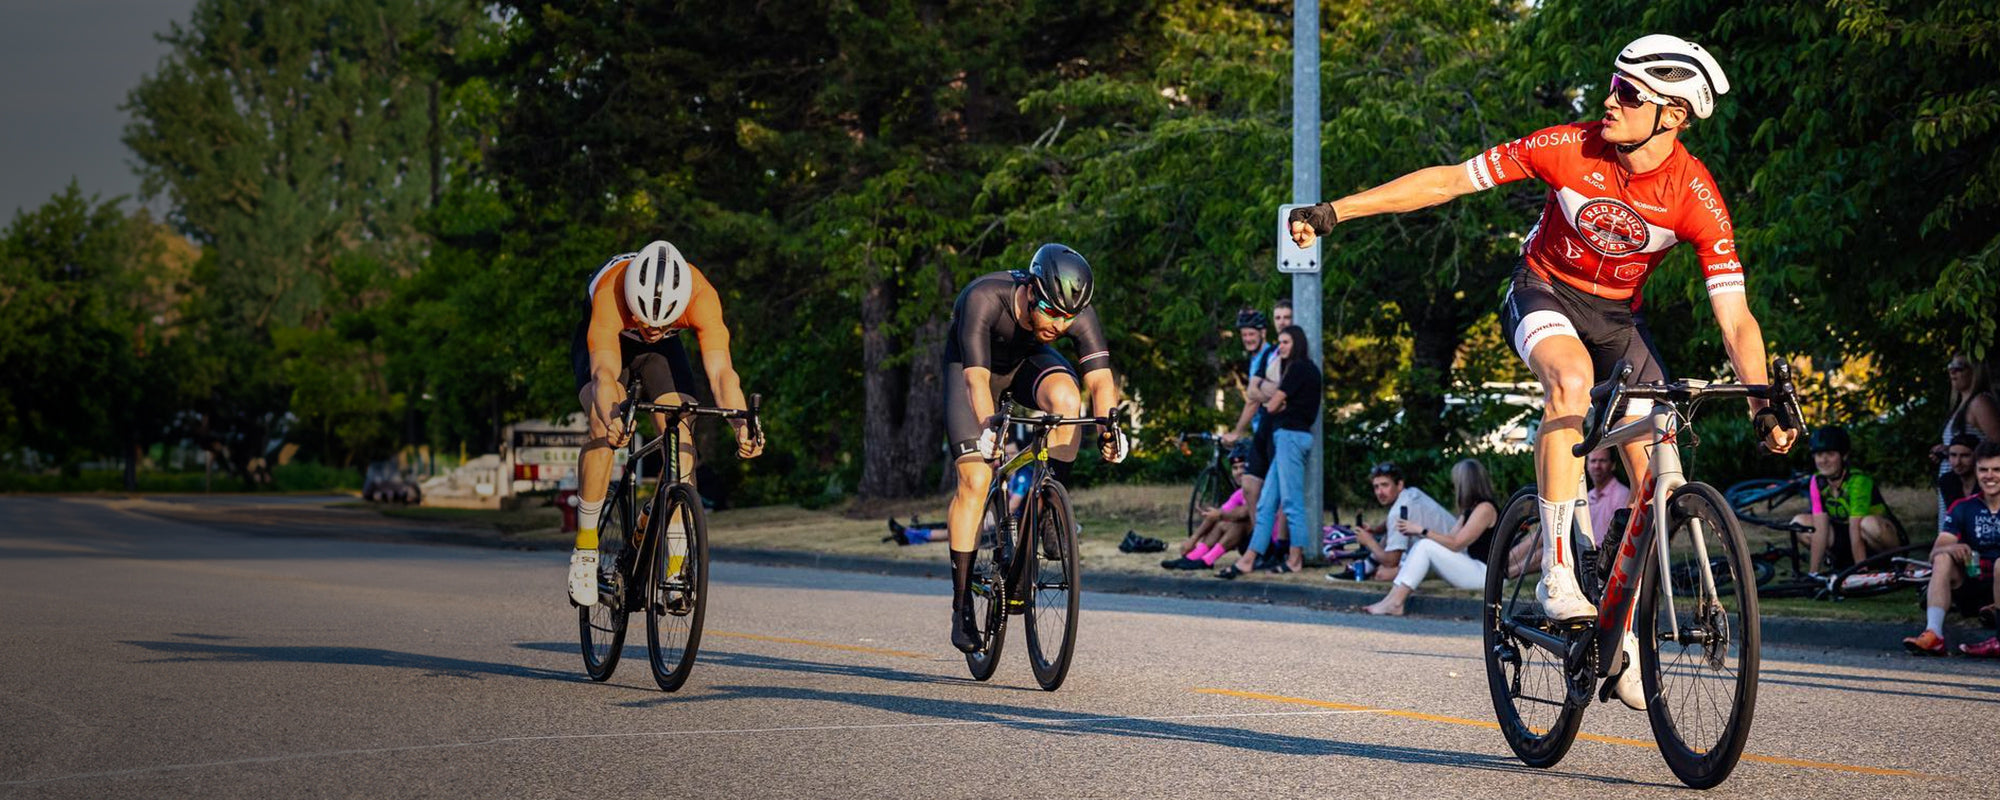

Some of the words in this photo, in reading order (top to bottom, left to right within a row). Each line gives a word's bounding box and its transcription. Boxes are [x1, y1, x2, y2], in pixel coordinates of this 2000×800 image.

[1525, 129, 1587, 151] MOSAIC
[1633, 200, 1668, 213] ROBINSON
[1688, 177, 1732, 233] MOSAIC
[1585, 205, 1609, 219] RED
[1611, 206, 1643, 237] TRUCK
[1590, 234, 1627, 250] BEER
